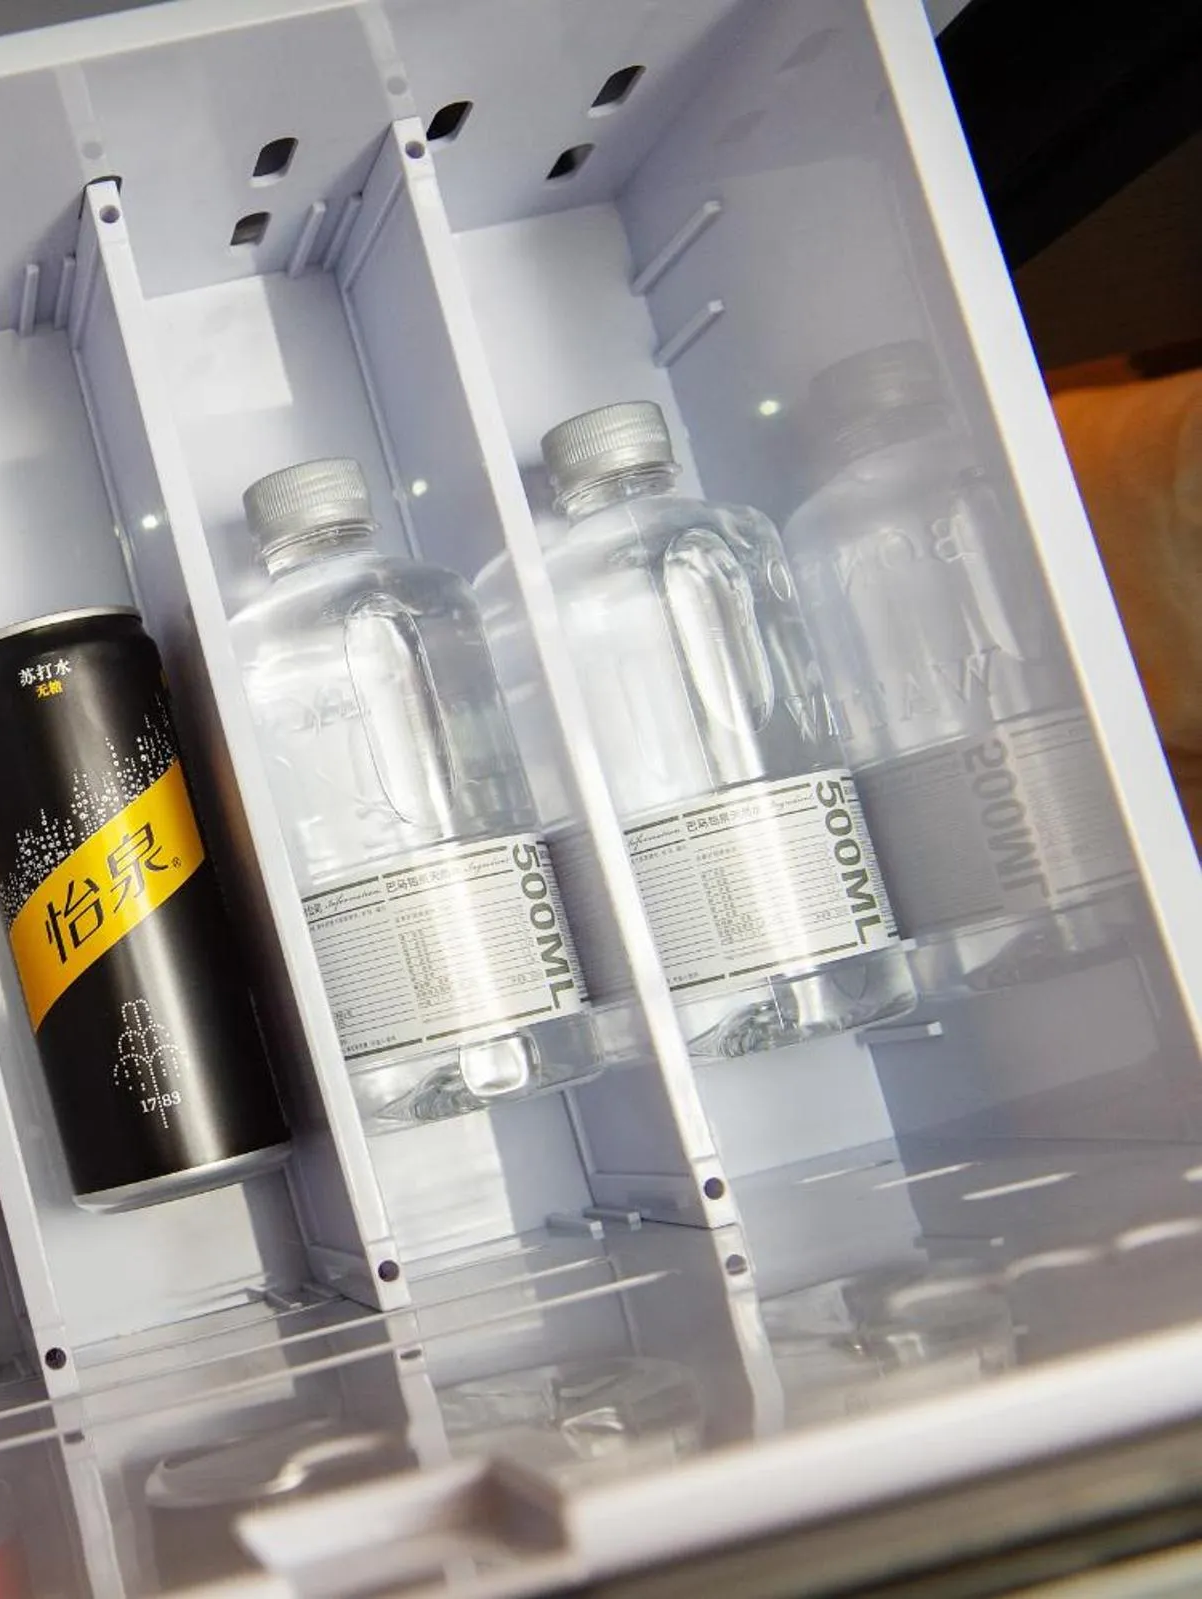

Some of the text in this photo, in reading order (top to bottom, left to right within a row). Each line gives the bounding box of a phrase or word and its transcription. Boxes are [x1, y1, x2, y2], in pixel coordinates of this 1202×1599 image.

[18, 658, 72, 687] 苏打水
[35, 679, 64, 699] 无糖
[44, 823, 168, 966] 怡泉
[512, 842, 576, 1010] 500ML
[816, 780, 883, 945] 500ML
